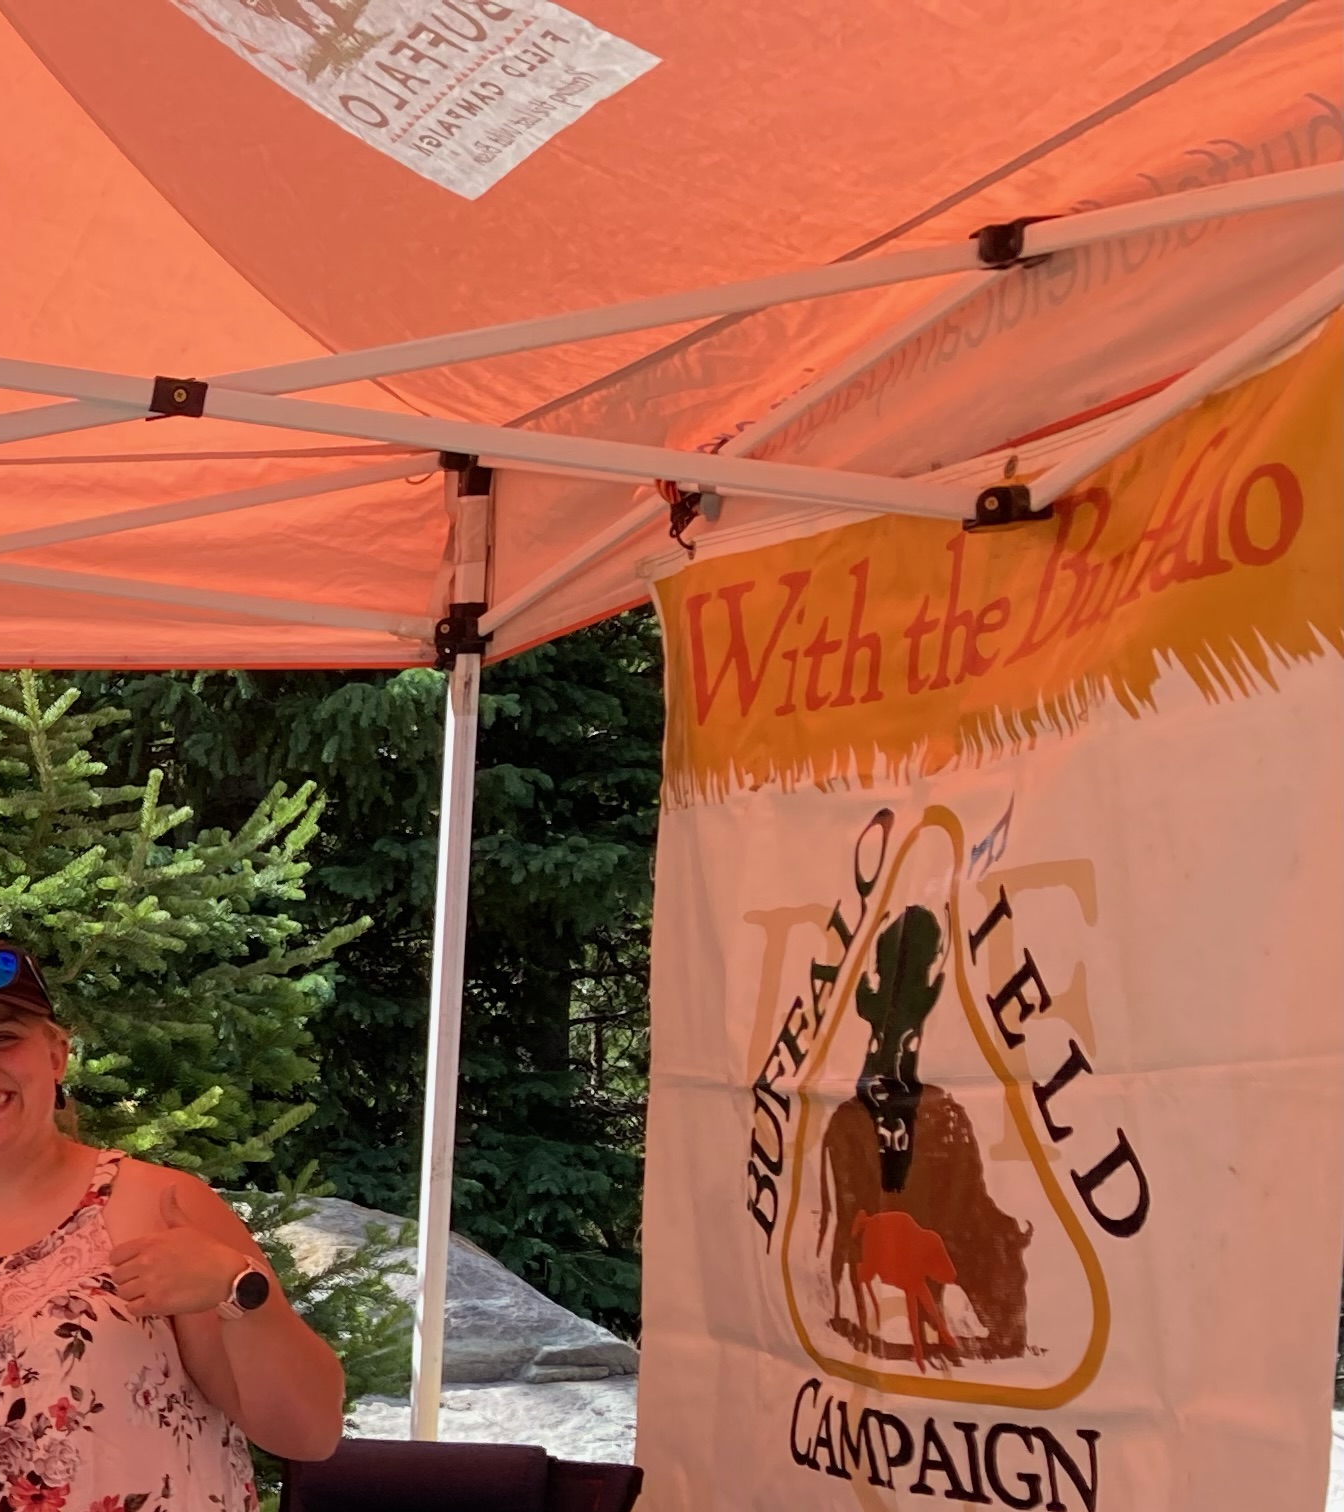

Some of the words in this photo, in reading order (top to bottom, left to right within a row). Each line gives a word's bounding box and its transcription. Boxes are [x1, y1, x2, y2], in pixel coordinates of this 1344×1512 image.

[686, 557, 883, 726] With
[903, 533, 1012, 695] the
[746, 806, 896, 1255] BUFFALO
[966, 791, 1152, 1239] FIELD
